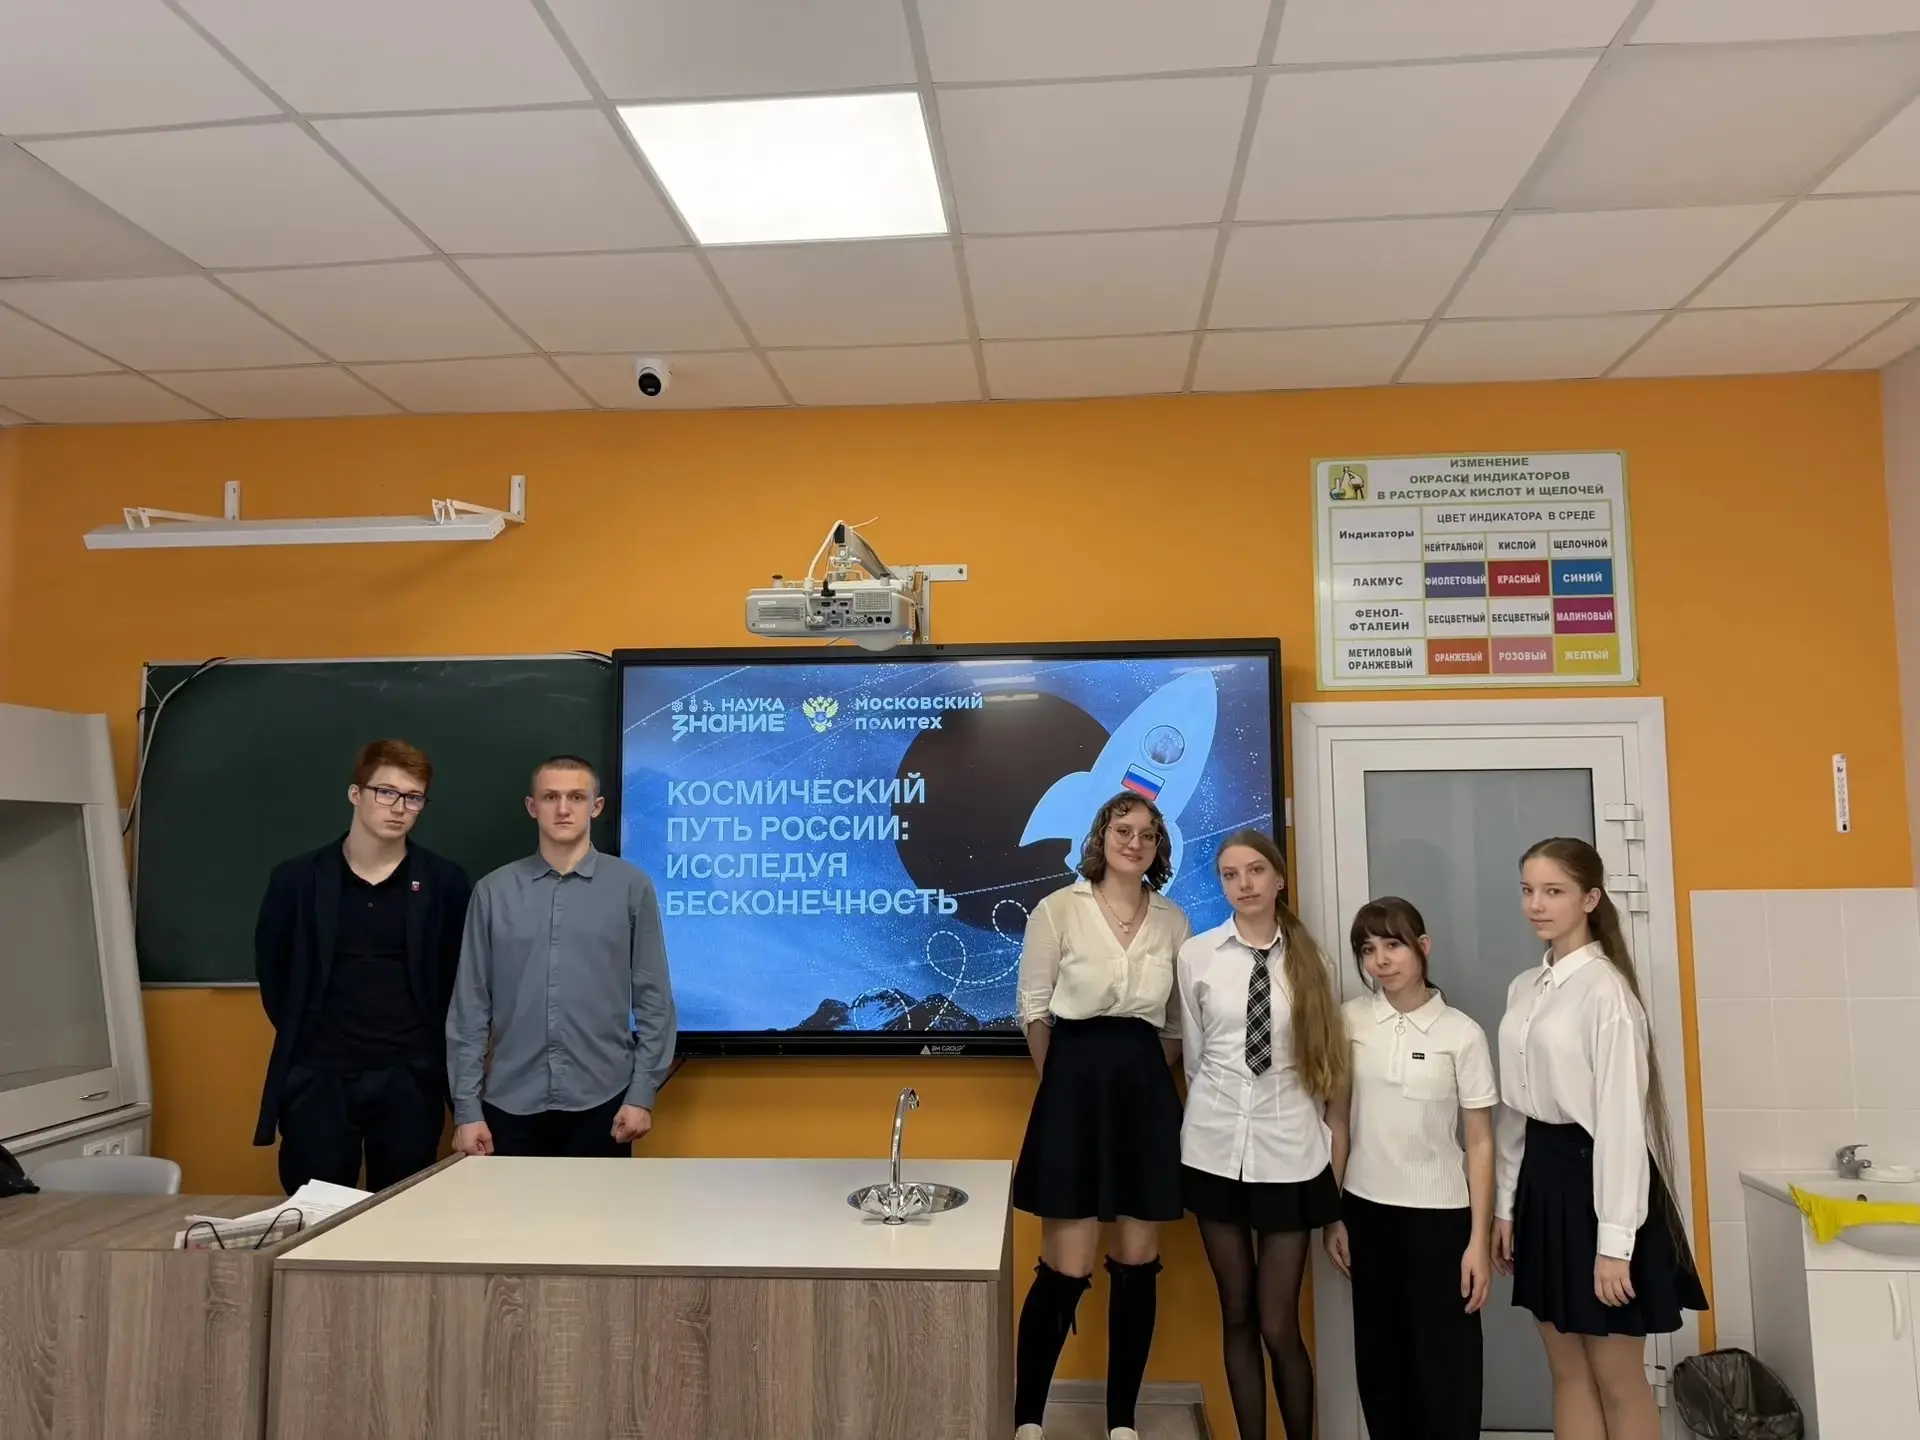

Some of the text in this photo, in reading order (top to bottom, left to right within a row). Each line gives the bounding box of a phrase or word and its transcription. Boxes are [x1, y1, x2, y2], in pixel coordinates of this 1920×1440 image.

[1450, 457, 1529, 468] ИЗМЕНЕНИЕ
[1409, 471, 1570, 485] ОКРАСКИ ИНДИКАТОРОВ
[1377, 483, 1604, 500] В РАСТВОРАХ КИСЛОТ И ЩЕЛОЧЕЙ
[1437, 510, 1595, 524] ЦВЕТ ИНДИКАТОРА В СРЕДЕ
[1339, 529, 1414, 540] Индикаторы
[1424, 541, 1484, 552] НЕЙТРАЛЬНОЙ
[1498, 539, 1536, 550] КИСЛОЙ
[1553, 537, 1608, 549] ЩЕЛОЧНОЙ
[1352, 576, 1403, 587] ЛАКМУС
[1424, 573, 1487, 586] ФИОЛЕТОВЫЙ
[1497, 572, 1541, 584] КРАСНЫЙ
[1562, 571, 1603, 583] СИНИЙ
[1355, 608, 1404, 618] ФЕНОЛ-
[1428, 612, 1486, 625] БЕСЦВЕТНЫЙ
[1491, 611, 1550, 624] БЕСЦВЕТНЫЙ
[1556, 609, 1613, 621] МАЛИНОВЫЙ
[1349, 621, 1410, 631] ФТАЛЕИН
[1348, 645, 1412, 657] МЕТИЛОВЫЙ
[1434, 651, 1483, 662] ОРАНЖЕВЫЙ
[1499, 648, 1547, 661] РОЗОВЫЙ
[1564, 647, 1609, 660] ЖЕЛТЫЙ
[1348, 658, 1413, 670] ОРАНЖЕВЫЙ
[721, 697, 785, 712] НАУКА
[667, 772, 926, 806] КОСМИЧЕСКИЙ
[666, 814, 909, 842] ПУТЬ РОССИИ:
[666, 852, 848, 883] ИССЛЕДУЯ
[665, 888, 958, 917] БЕСКОНЕЧНОСТЬ
